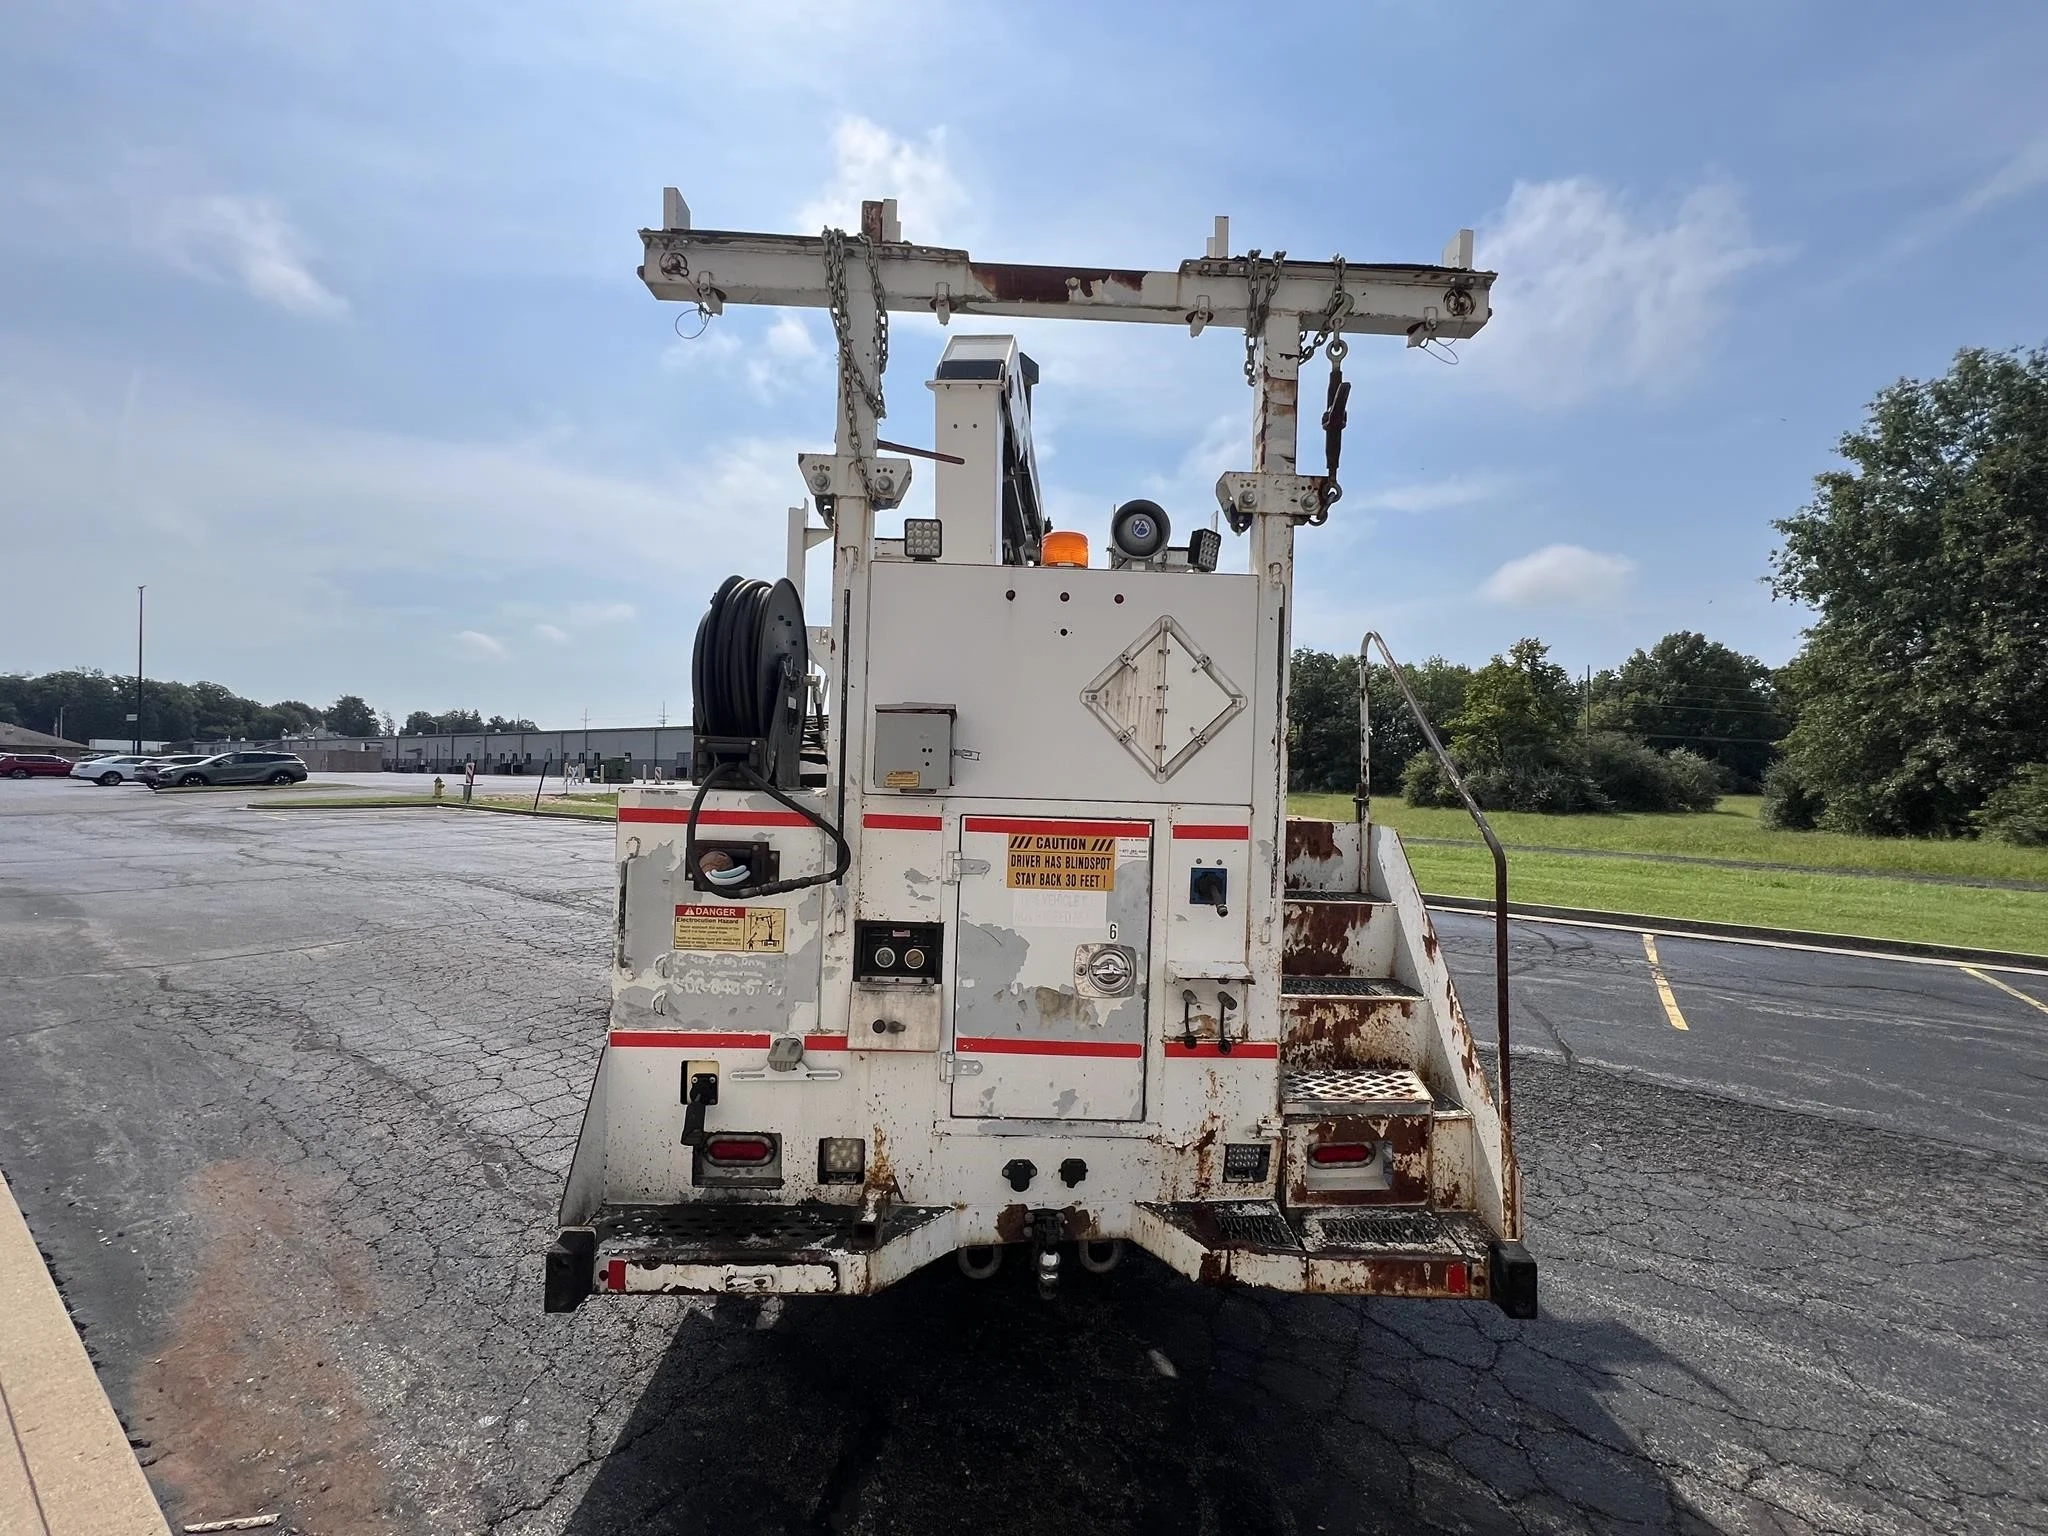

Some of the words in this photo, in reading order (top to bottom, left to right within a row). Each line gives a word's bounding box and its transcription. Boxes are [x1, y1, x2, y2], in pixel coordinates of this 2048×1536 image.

[1036, 837, 1086, 850] CAUTION
[1011, 855, 1041, 868] DRIVER
[1044, 856, 1062, 869] HAS
[1065, 856, 1112, 870] BLINDSPOT
[1015, 872, 1036, 885] STAY
[1039, 873, 1062, 887] BACK
[1065, 873, 1076, 887] 30
[1080, 874, 1101, 887] FEET
[695, 907, 736, 917] DANGER
[1109, 923, 1118, 940] 6
